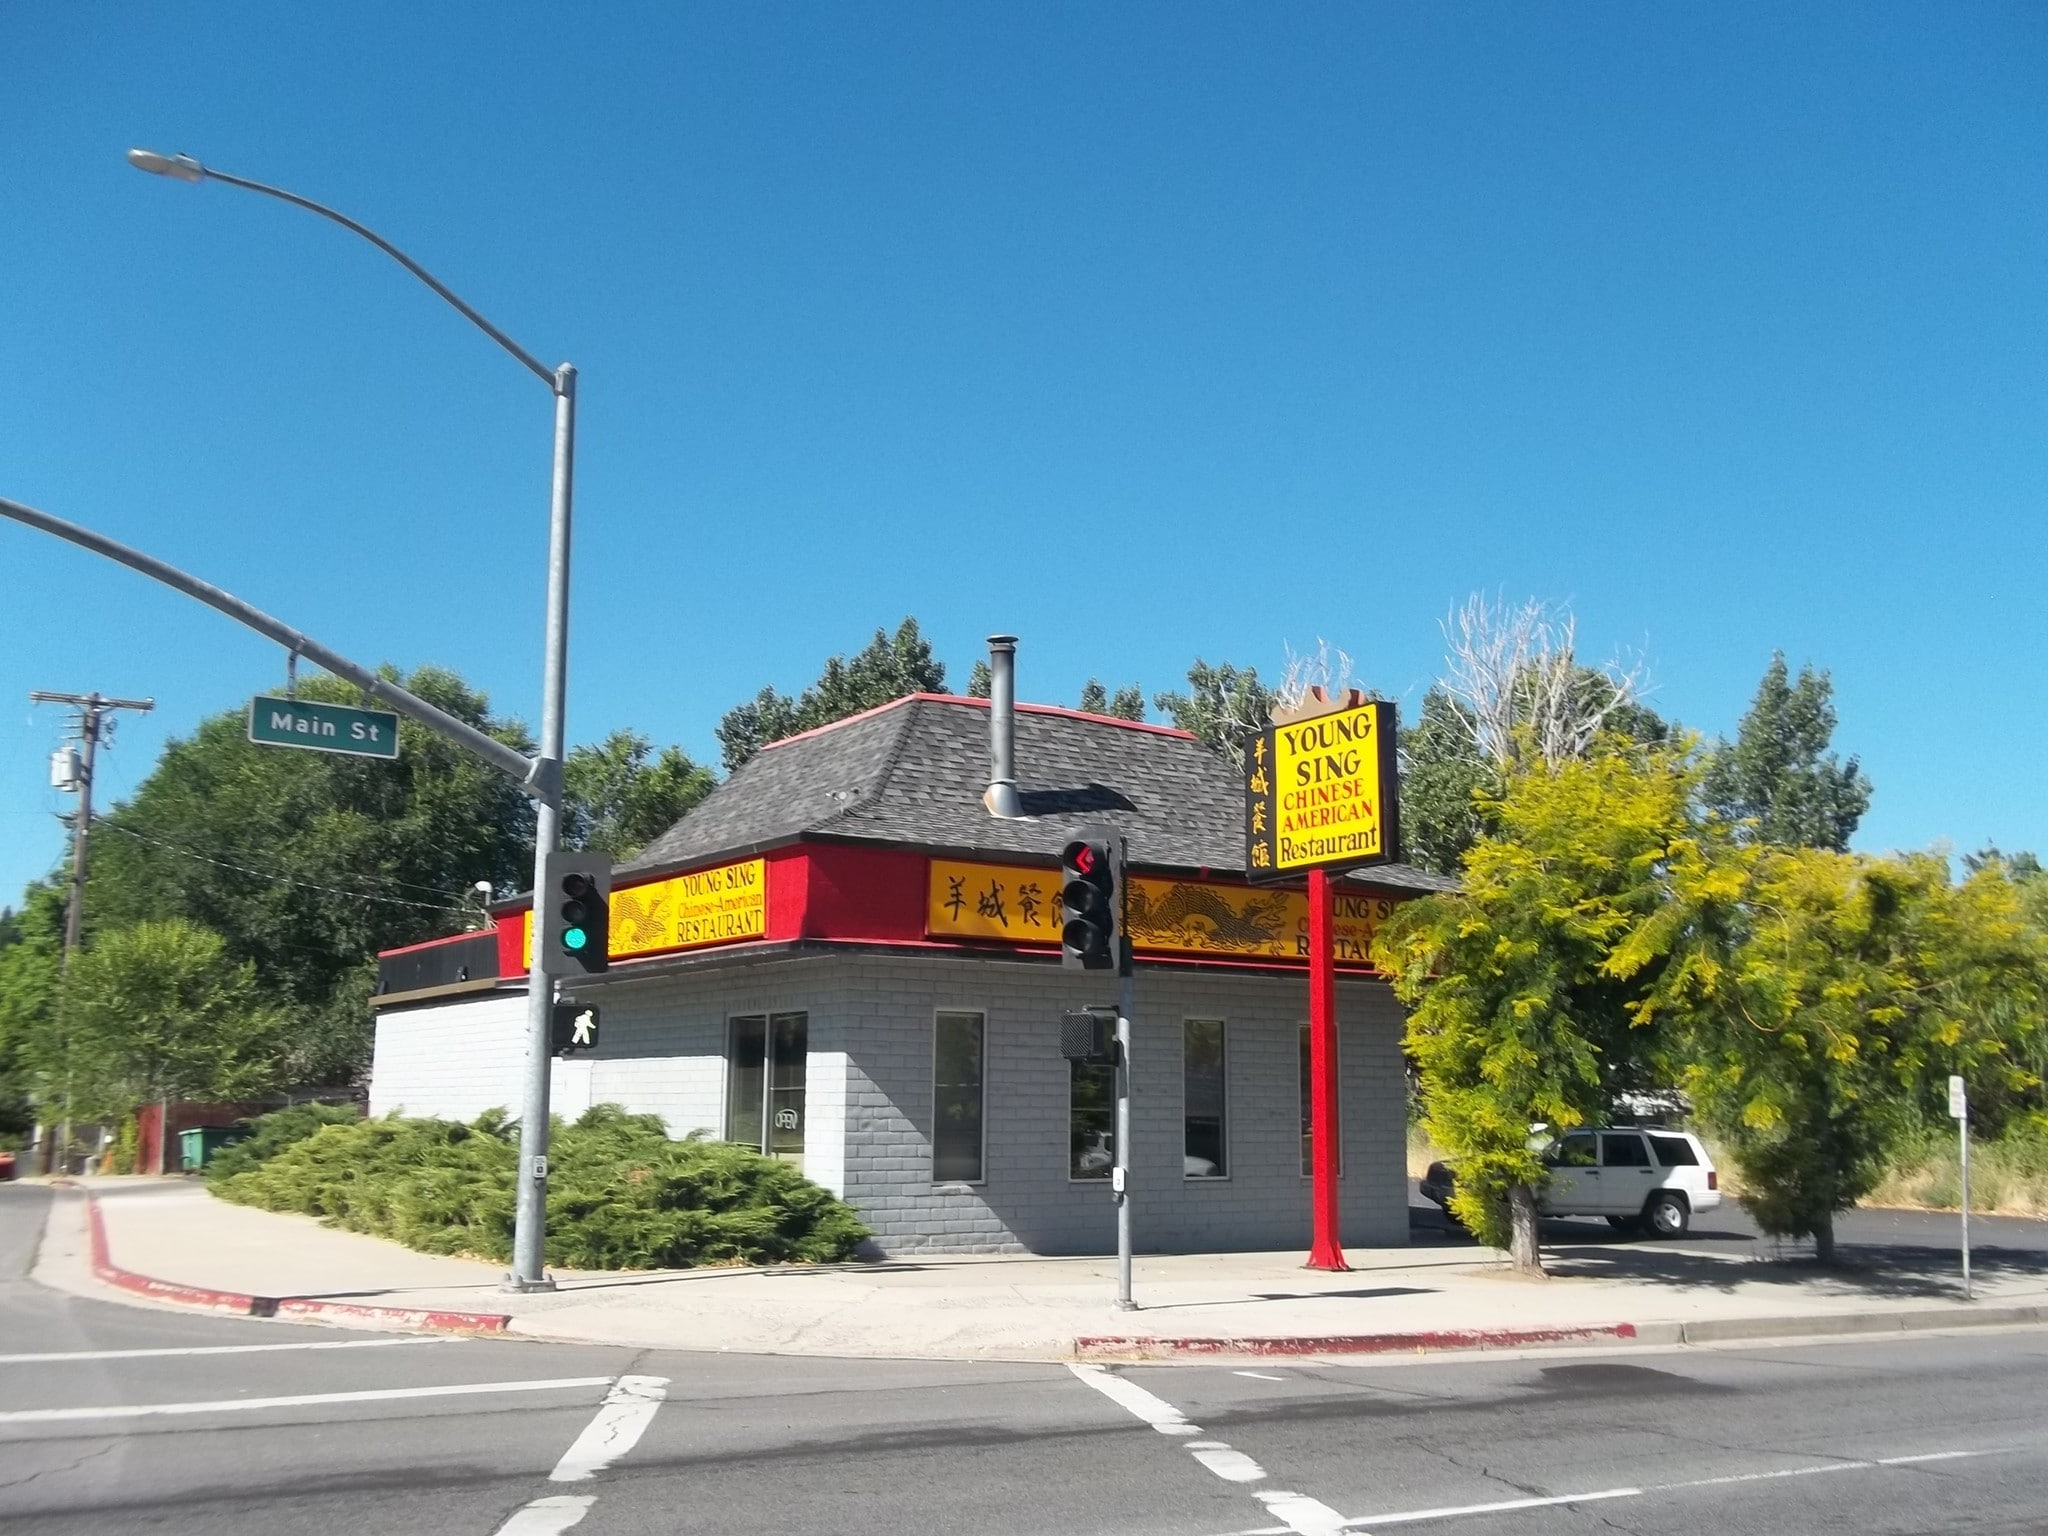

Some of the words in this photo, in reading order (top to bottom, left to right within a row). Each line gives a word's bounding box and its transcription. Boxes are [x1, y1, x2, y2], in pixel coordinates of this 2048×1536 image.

[270, 711, 336, 737] Main
[350, 721, 380, 742] St
[1284, 712, 1372, 756] YOUNG
[1296, 749, 1361, 787] SING
[1283, 777, 1365, 811] CHINESE
[1282, 799, 1374, 833] AMERICAN
[1280, 821, 1378, 863] Restaurant
[682, 870, 721, 898] YOUNG
[726, 862, 756, 890] SING
[677, 908, 763, 943] RESTAURANT
[774, 1110, 798, 1130] OPEN
